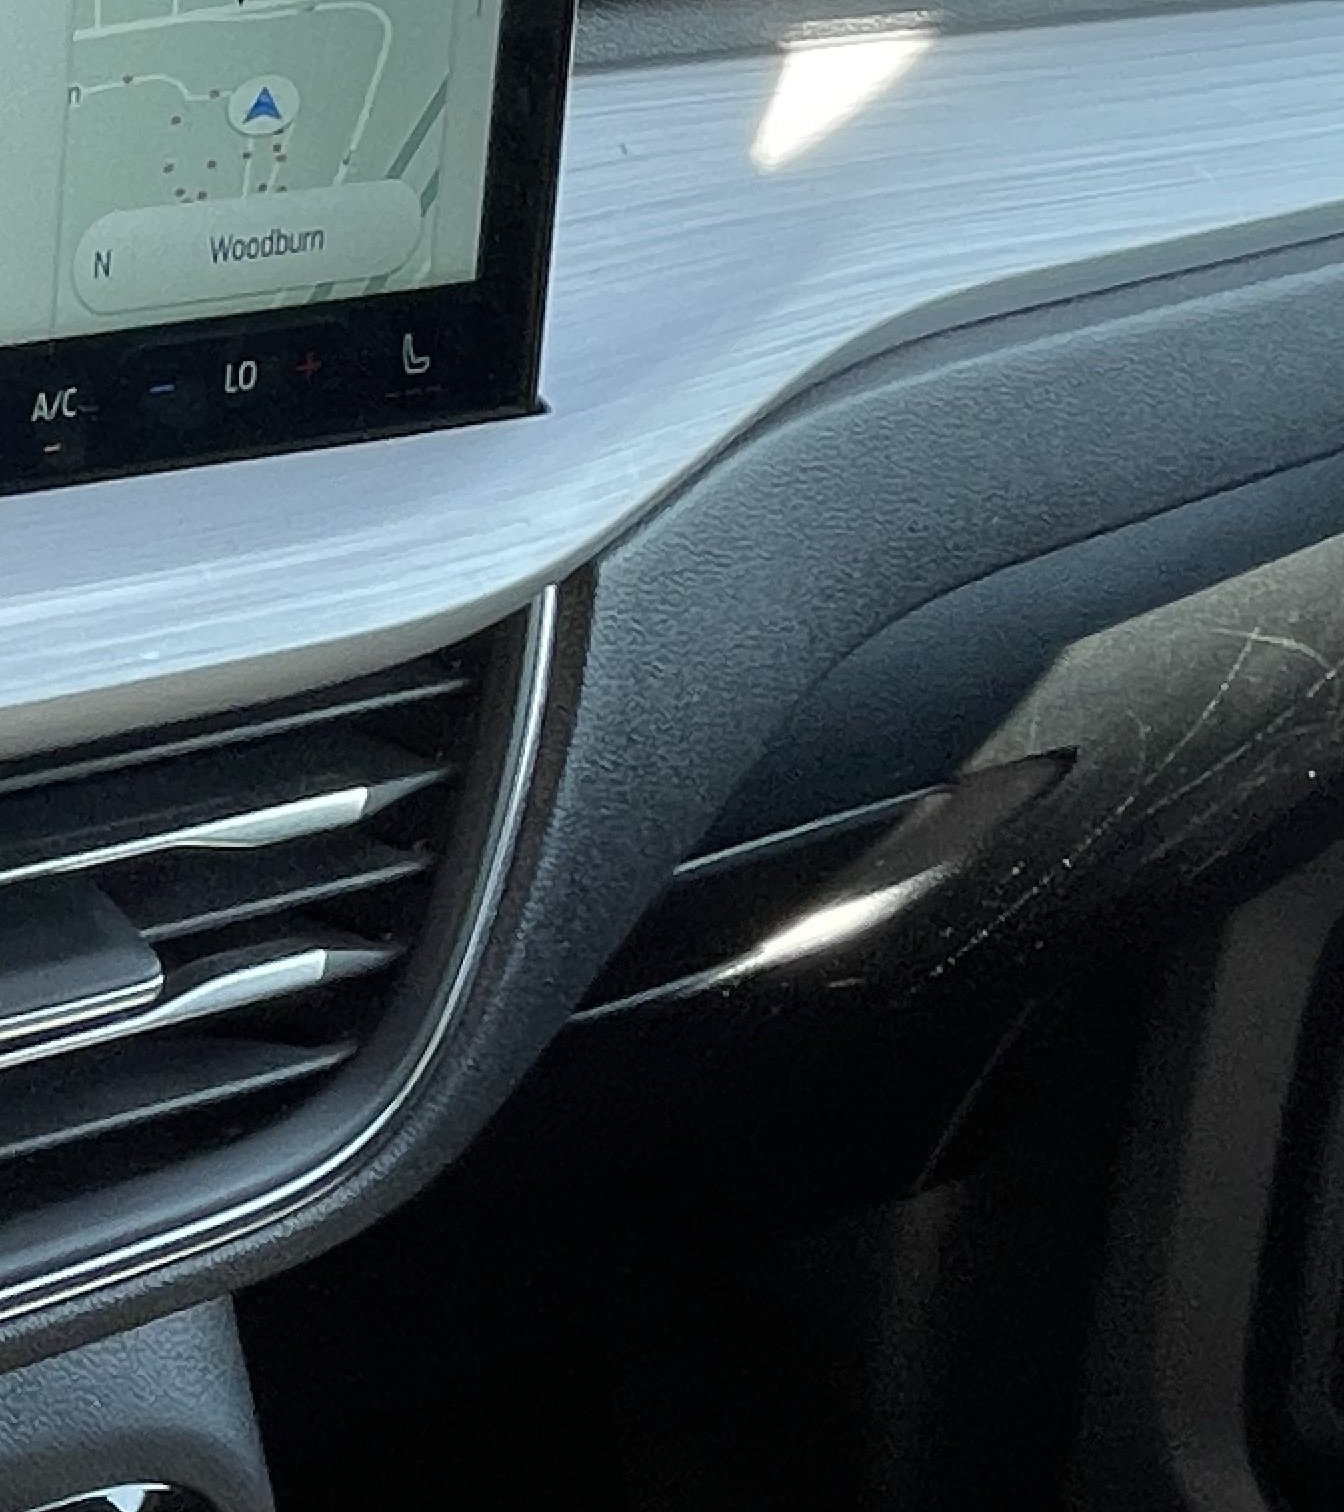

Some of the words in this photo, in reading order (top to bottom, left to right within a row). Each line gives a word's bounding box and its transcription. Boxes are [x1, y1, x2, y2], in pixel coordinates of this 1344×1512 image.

[210, 230, 324, 263] Woodburn
[225, 361, 256, 393] LO
[32, 388, 77, 421] A/C
